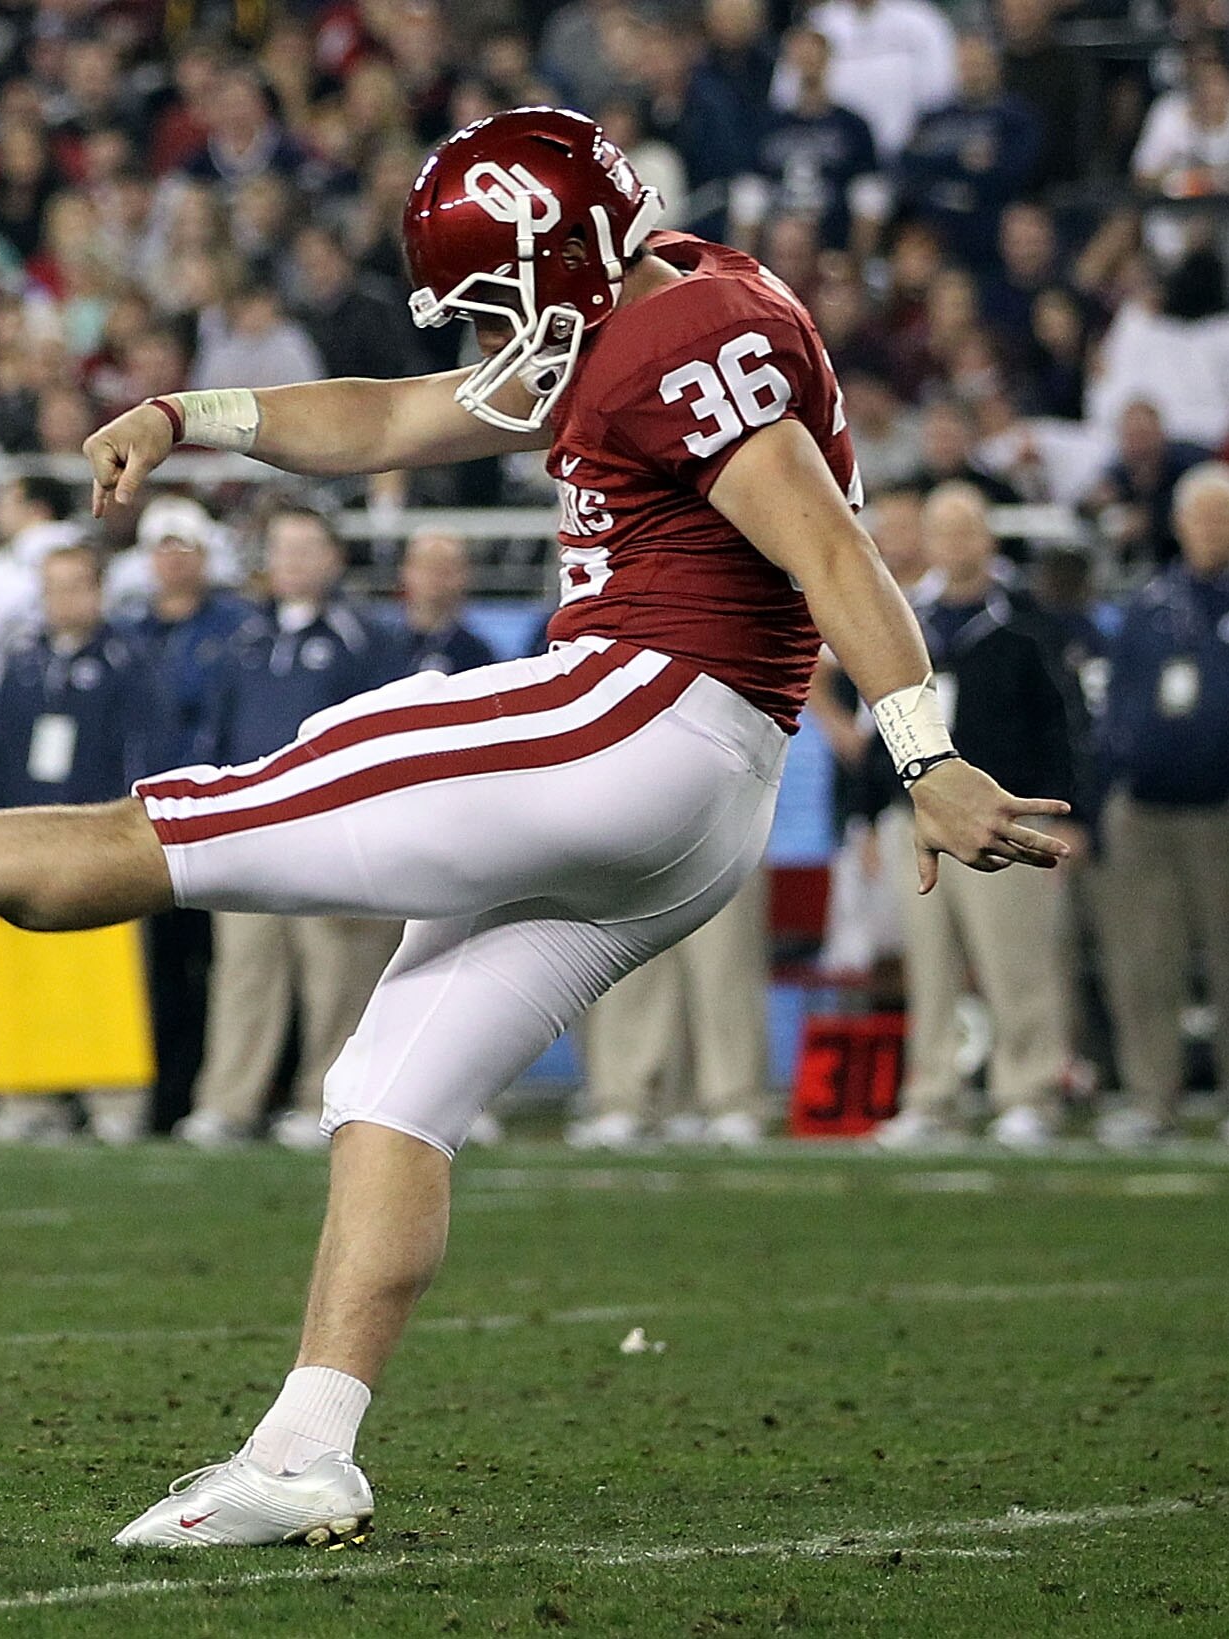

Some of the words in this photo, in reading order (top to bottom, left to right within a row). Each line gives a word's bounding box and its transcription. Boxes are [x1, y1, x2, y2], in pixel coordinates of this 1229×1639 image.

[463, 161, 562, 234] OU
[658, 331, 792, 459] 36
[804, 1032, 905, 1121] 30
